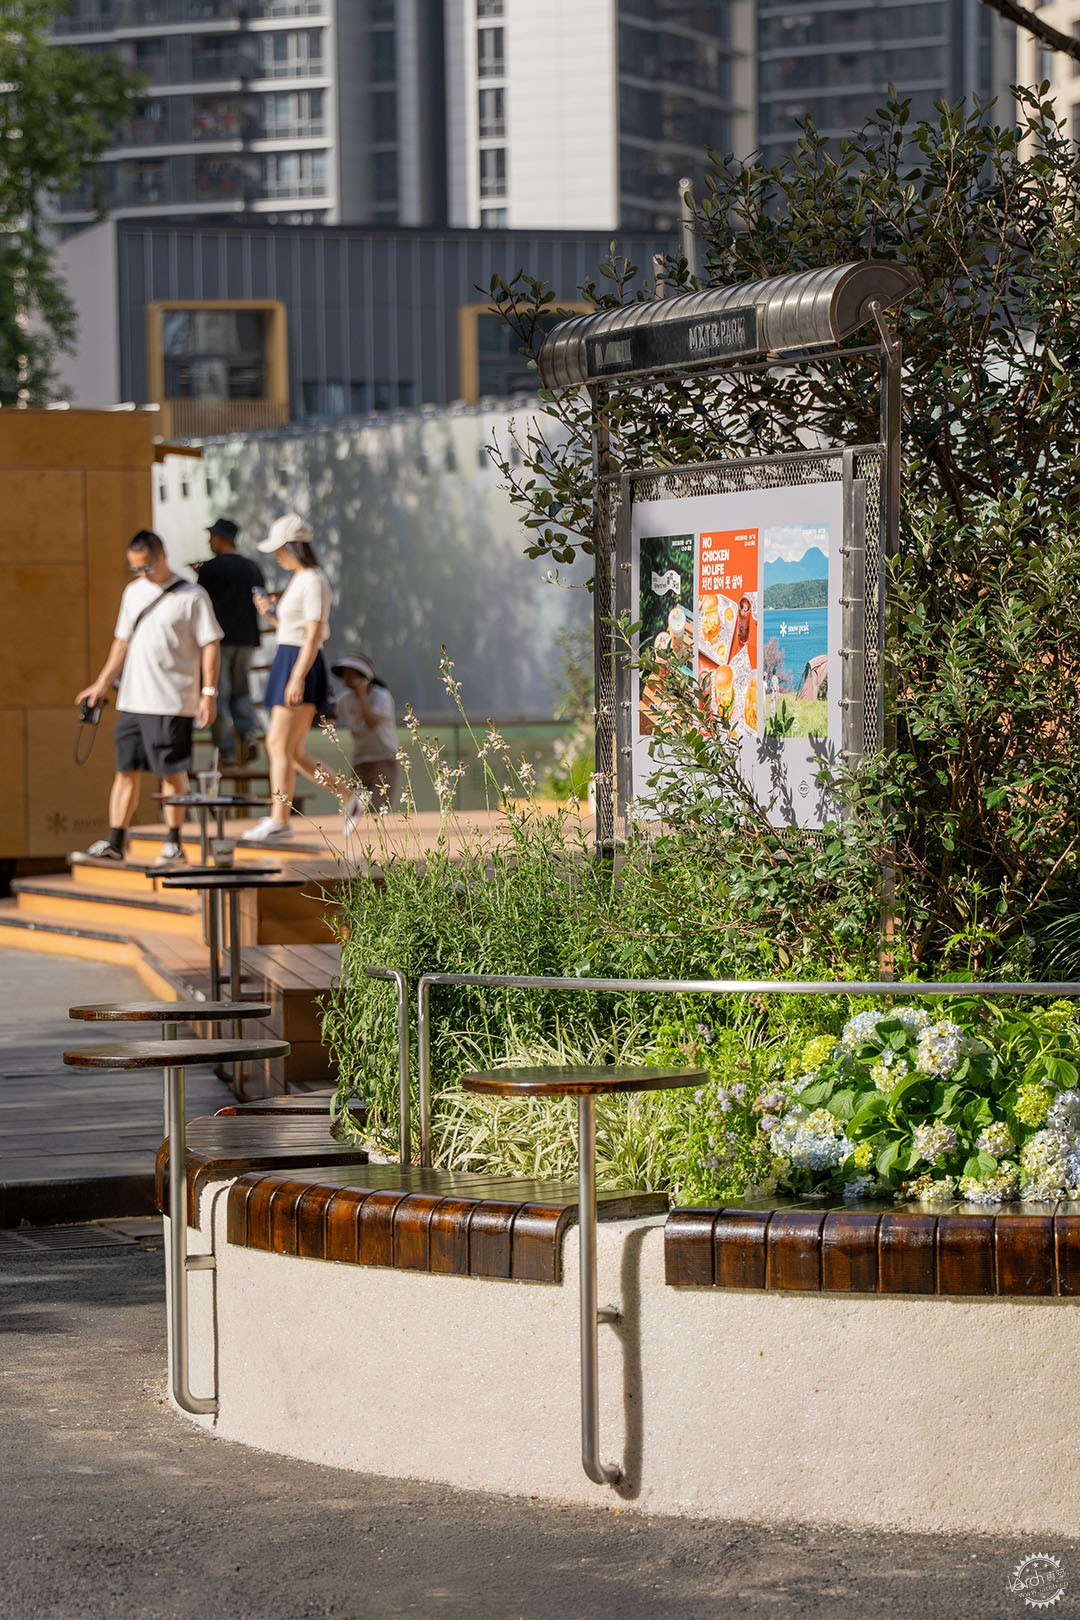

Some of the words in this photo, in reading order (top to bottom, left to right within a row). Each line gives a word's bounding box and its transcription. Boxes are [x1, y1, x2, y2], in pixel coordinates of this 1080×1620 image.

[720, 317, 746, 345] PARK
[702, 536, 712, 549] NO
[702, 549, 730, 562] CHICKEN
[702, 564, 711, 576] NO
[711, 563, 725, 575] LIFE
